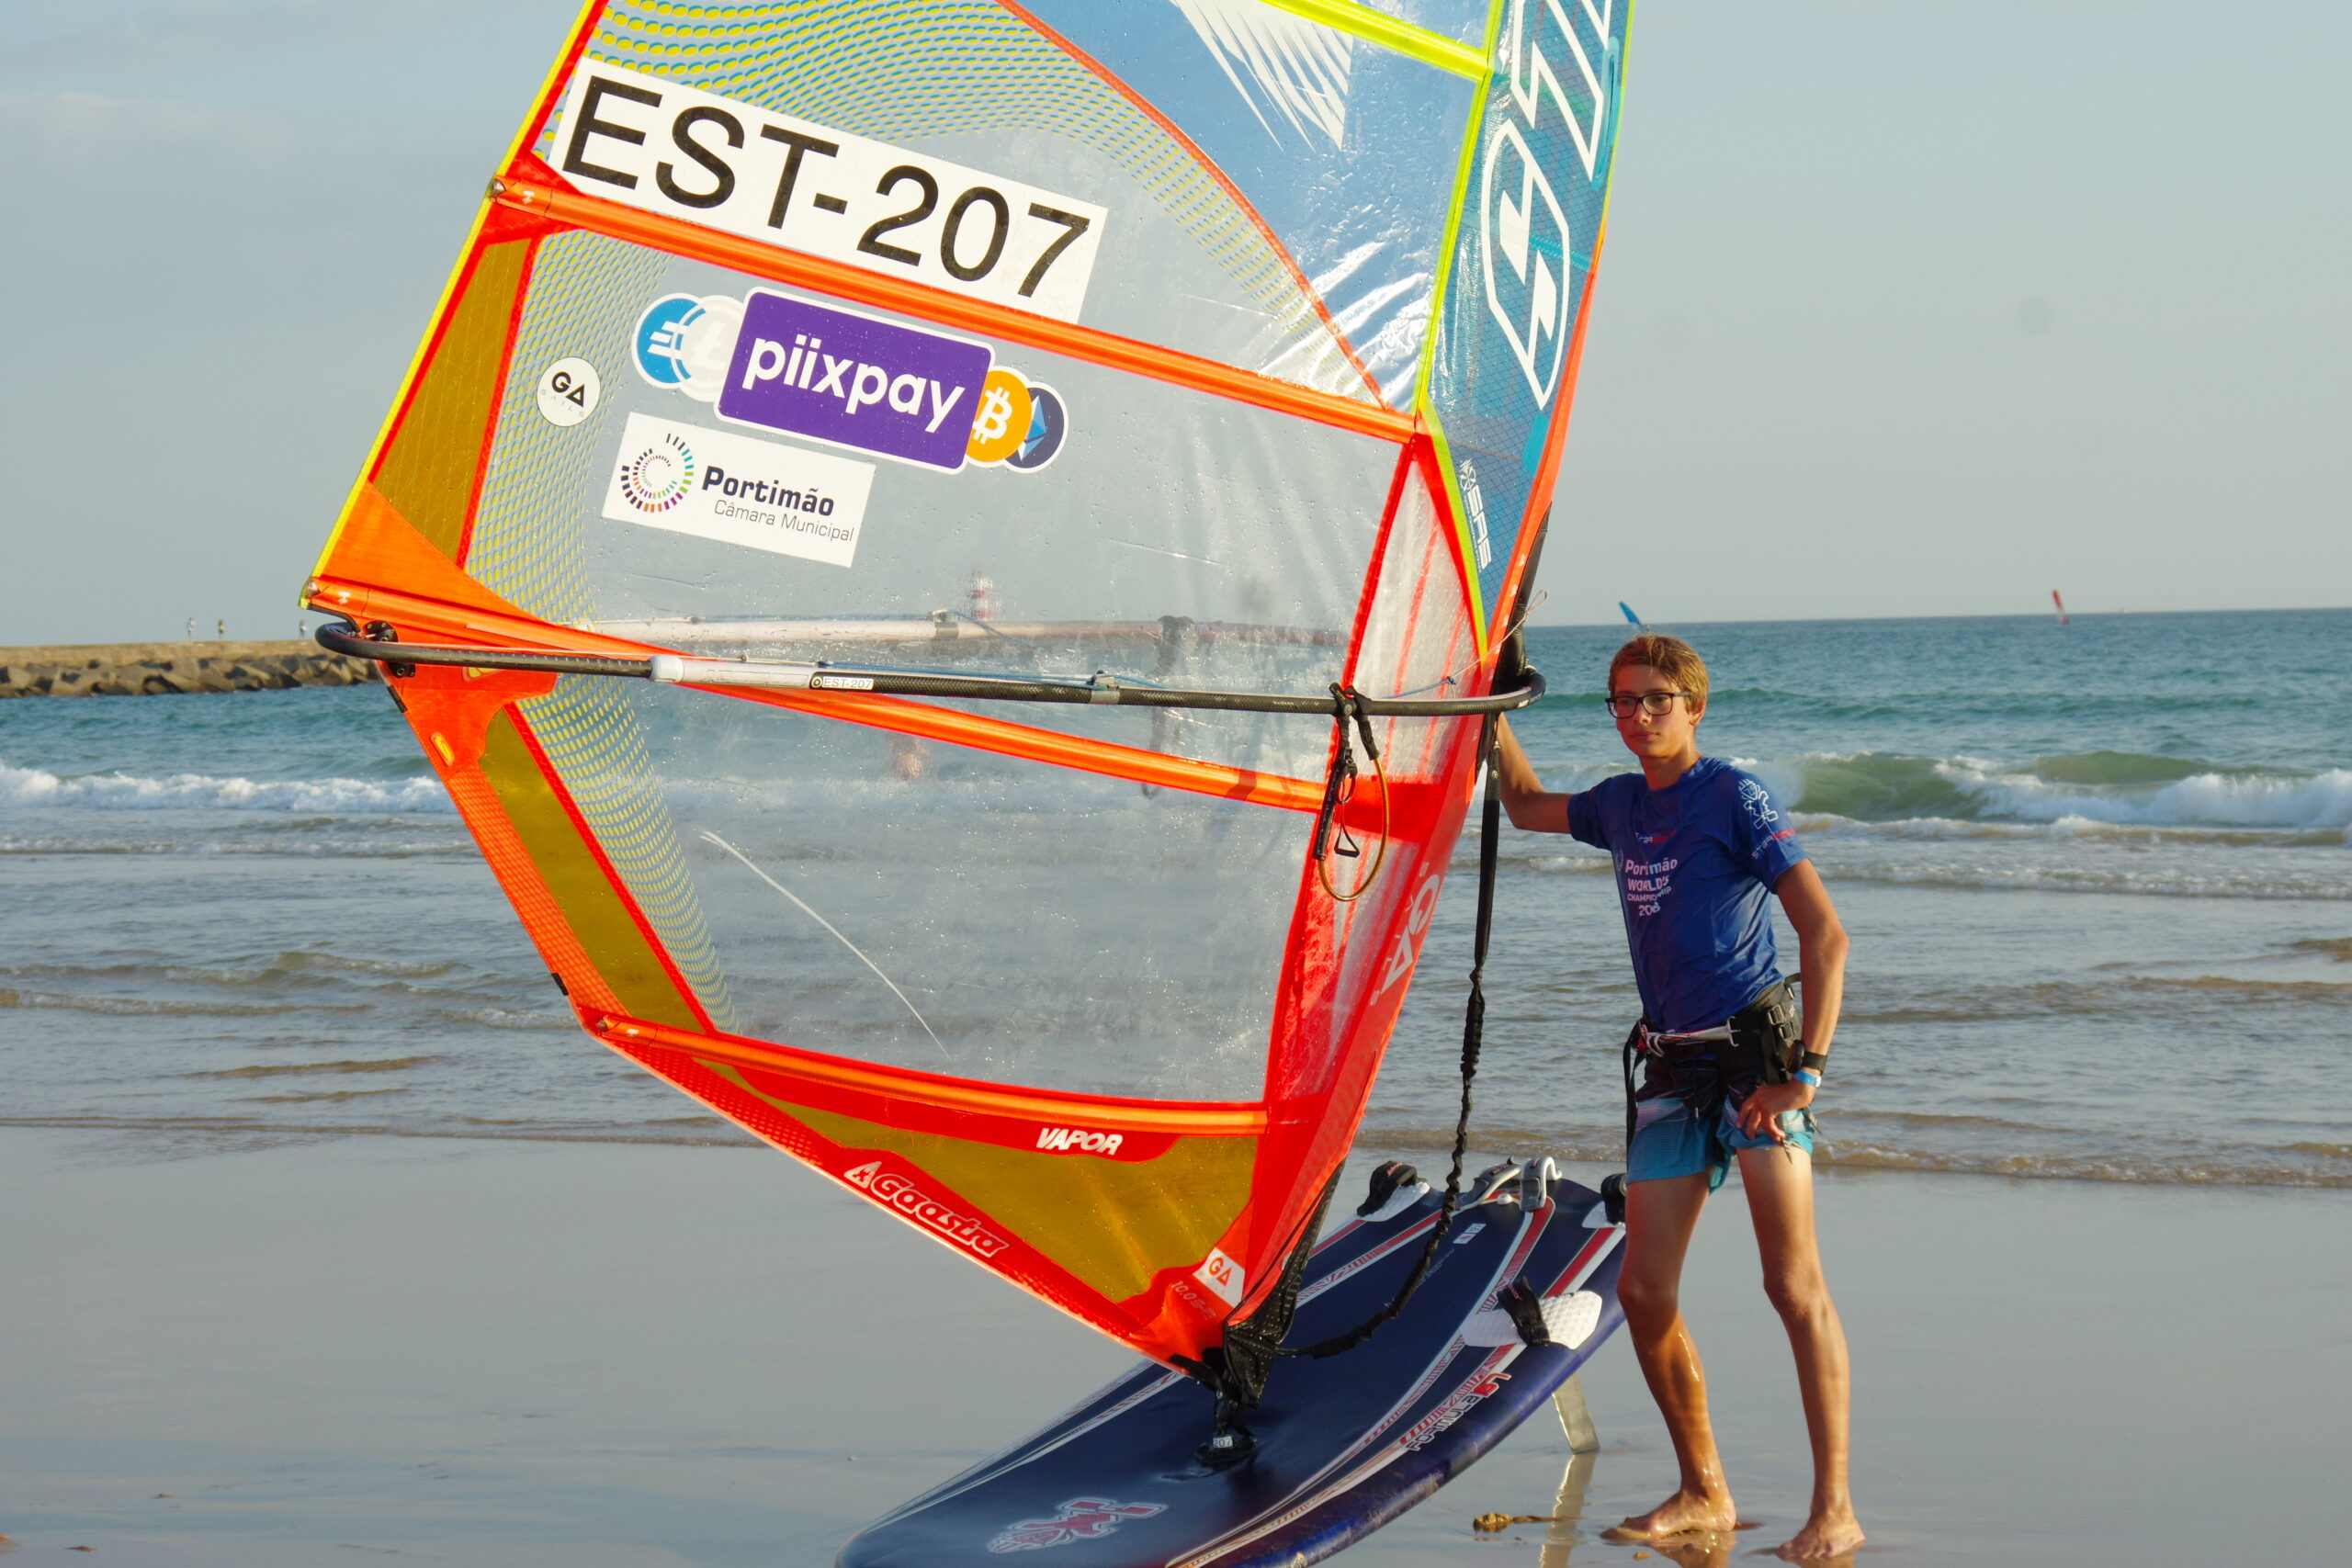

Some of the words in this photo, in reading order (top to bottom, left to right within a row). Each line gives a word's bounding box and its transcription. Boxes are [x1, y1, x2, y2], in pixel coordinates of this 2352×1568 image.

[562, 75, 1091, 298] EST-207
[552, 371, 585, 408] GA
[741, 333, 966, 434] piixpay
[702, 465, 834, 516] Portimão
[714, 499, 775, 526] Câmara
[780, 513, 855, 543] Municipal
[823, 677, 872, 690] EST-207
[1625, 857, 1679, 875] Porimão
[1627, 886, 1672, 902] CHAMPIOHIP
[1380, 873, 1442, 995] GA
[1035, 1127, 1124, 1156] VAPOR
[869, 1172, 1011, 1258] Gaastra
[1208, 1257, 1233, 1287] GA
[1213, 1437, 1232, 1448] 207
